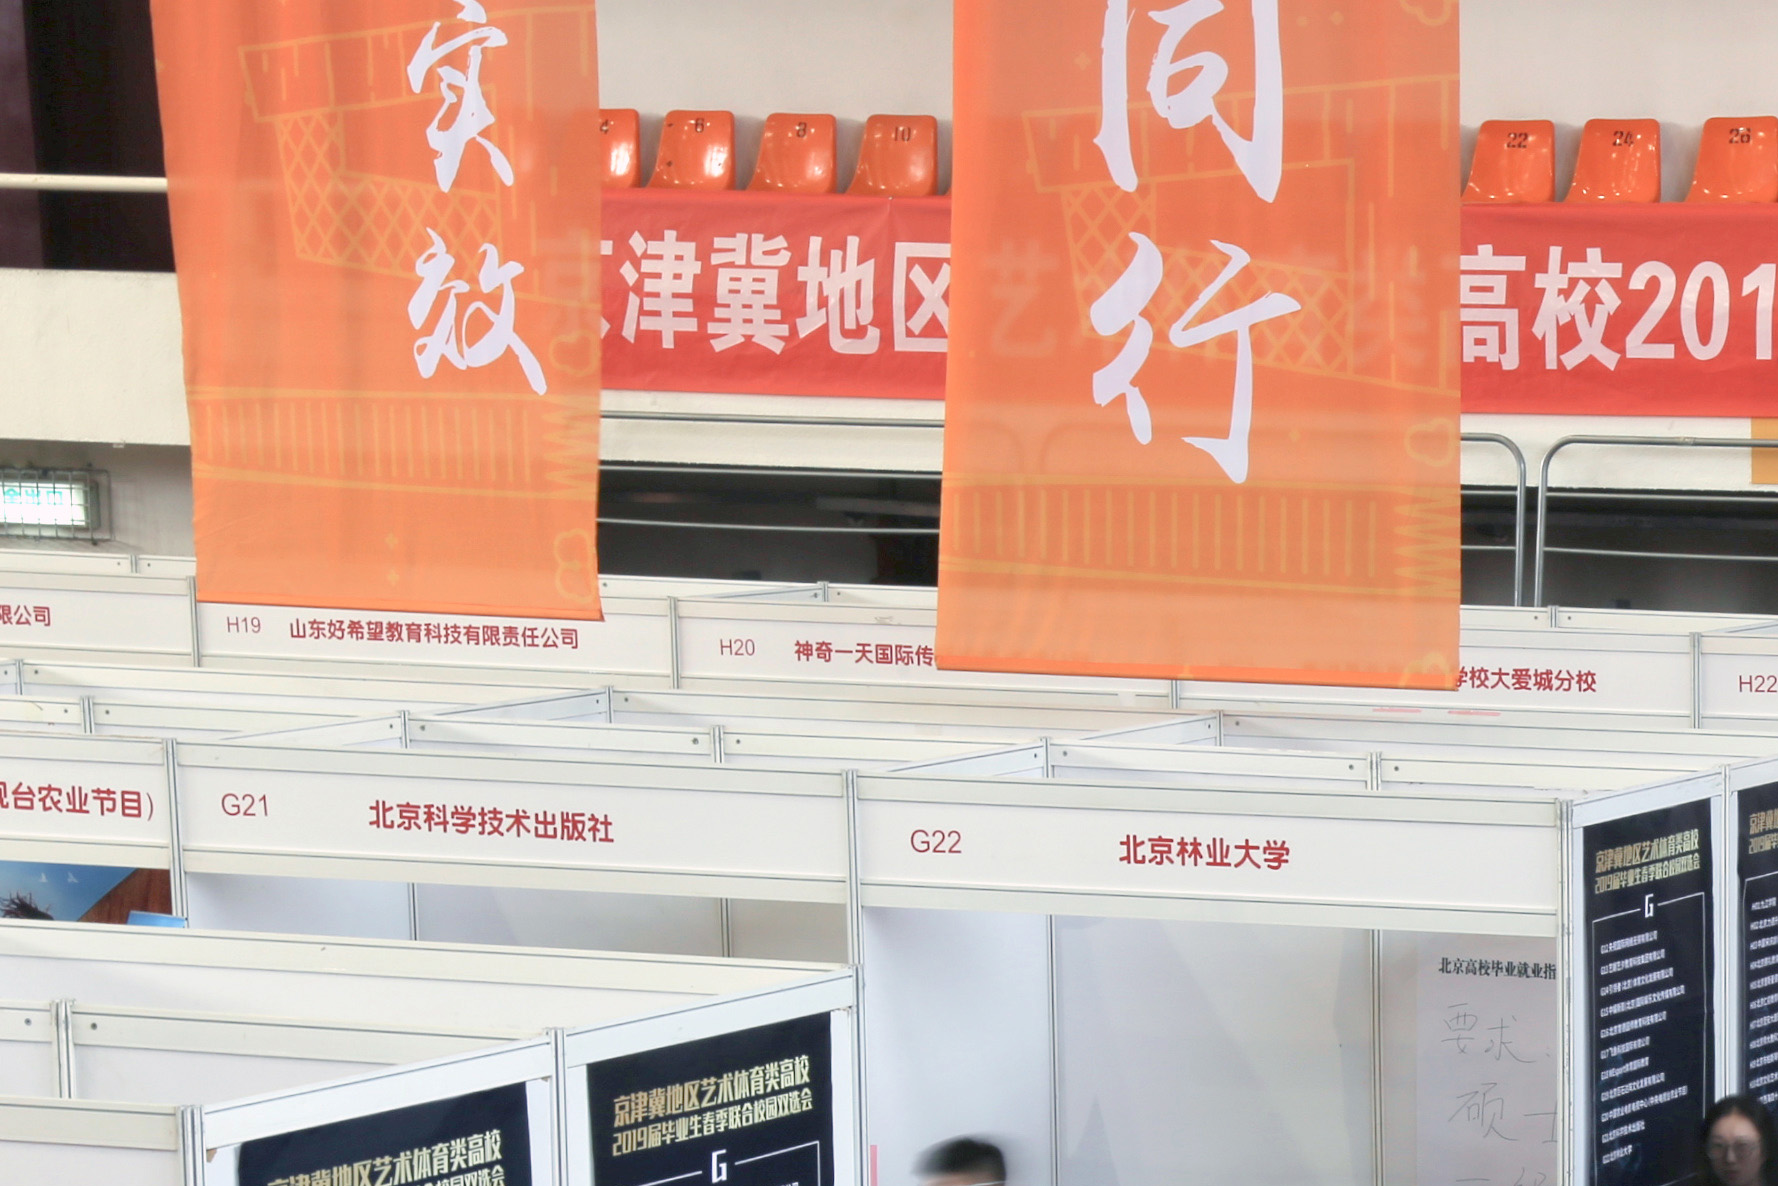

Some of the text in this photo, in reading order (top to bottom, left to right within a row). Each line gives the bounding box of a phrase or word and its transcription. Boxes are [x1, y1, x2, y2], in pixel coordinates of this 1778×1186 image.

[894, 126, 911, 142] 10
[1506, 131, 1529, 149] 22
[1612, 130, 1635, 147] 24
[600, 228, 953, 356] 津冀地区
[0, 604, 51, 627] 限公司
[226, 616, 580, 650] H19 山东好希望教育科技有限责任公司
[719, 637, 935, 668] H20 神奇一天国际传
[1738, 674, 1778, 695] H22
[221, 793, 615, 844] G21 北京科学技术出版社
[909, 828, 1292, 871] G22 北京林业大学
[1643, 893, 1655, 918] G
[1438, 957, 1557, 980] 北京高校毕业就业指
[614, 1053, 810, 1128] 京津冀地区艺术体育类高校
[612, 1087, 813, 1157] 2019届毕业生春季联合校园双选会
[711, 1149, 728, 1184] G
